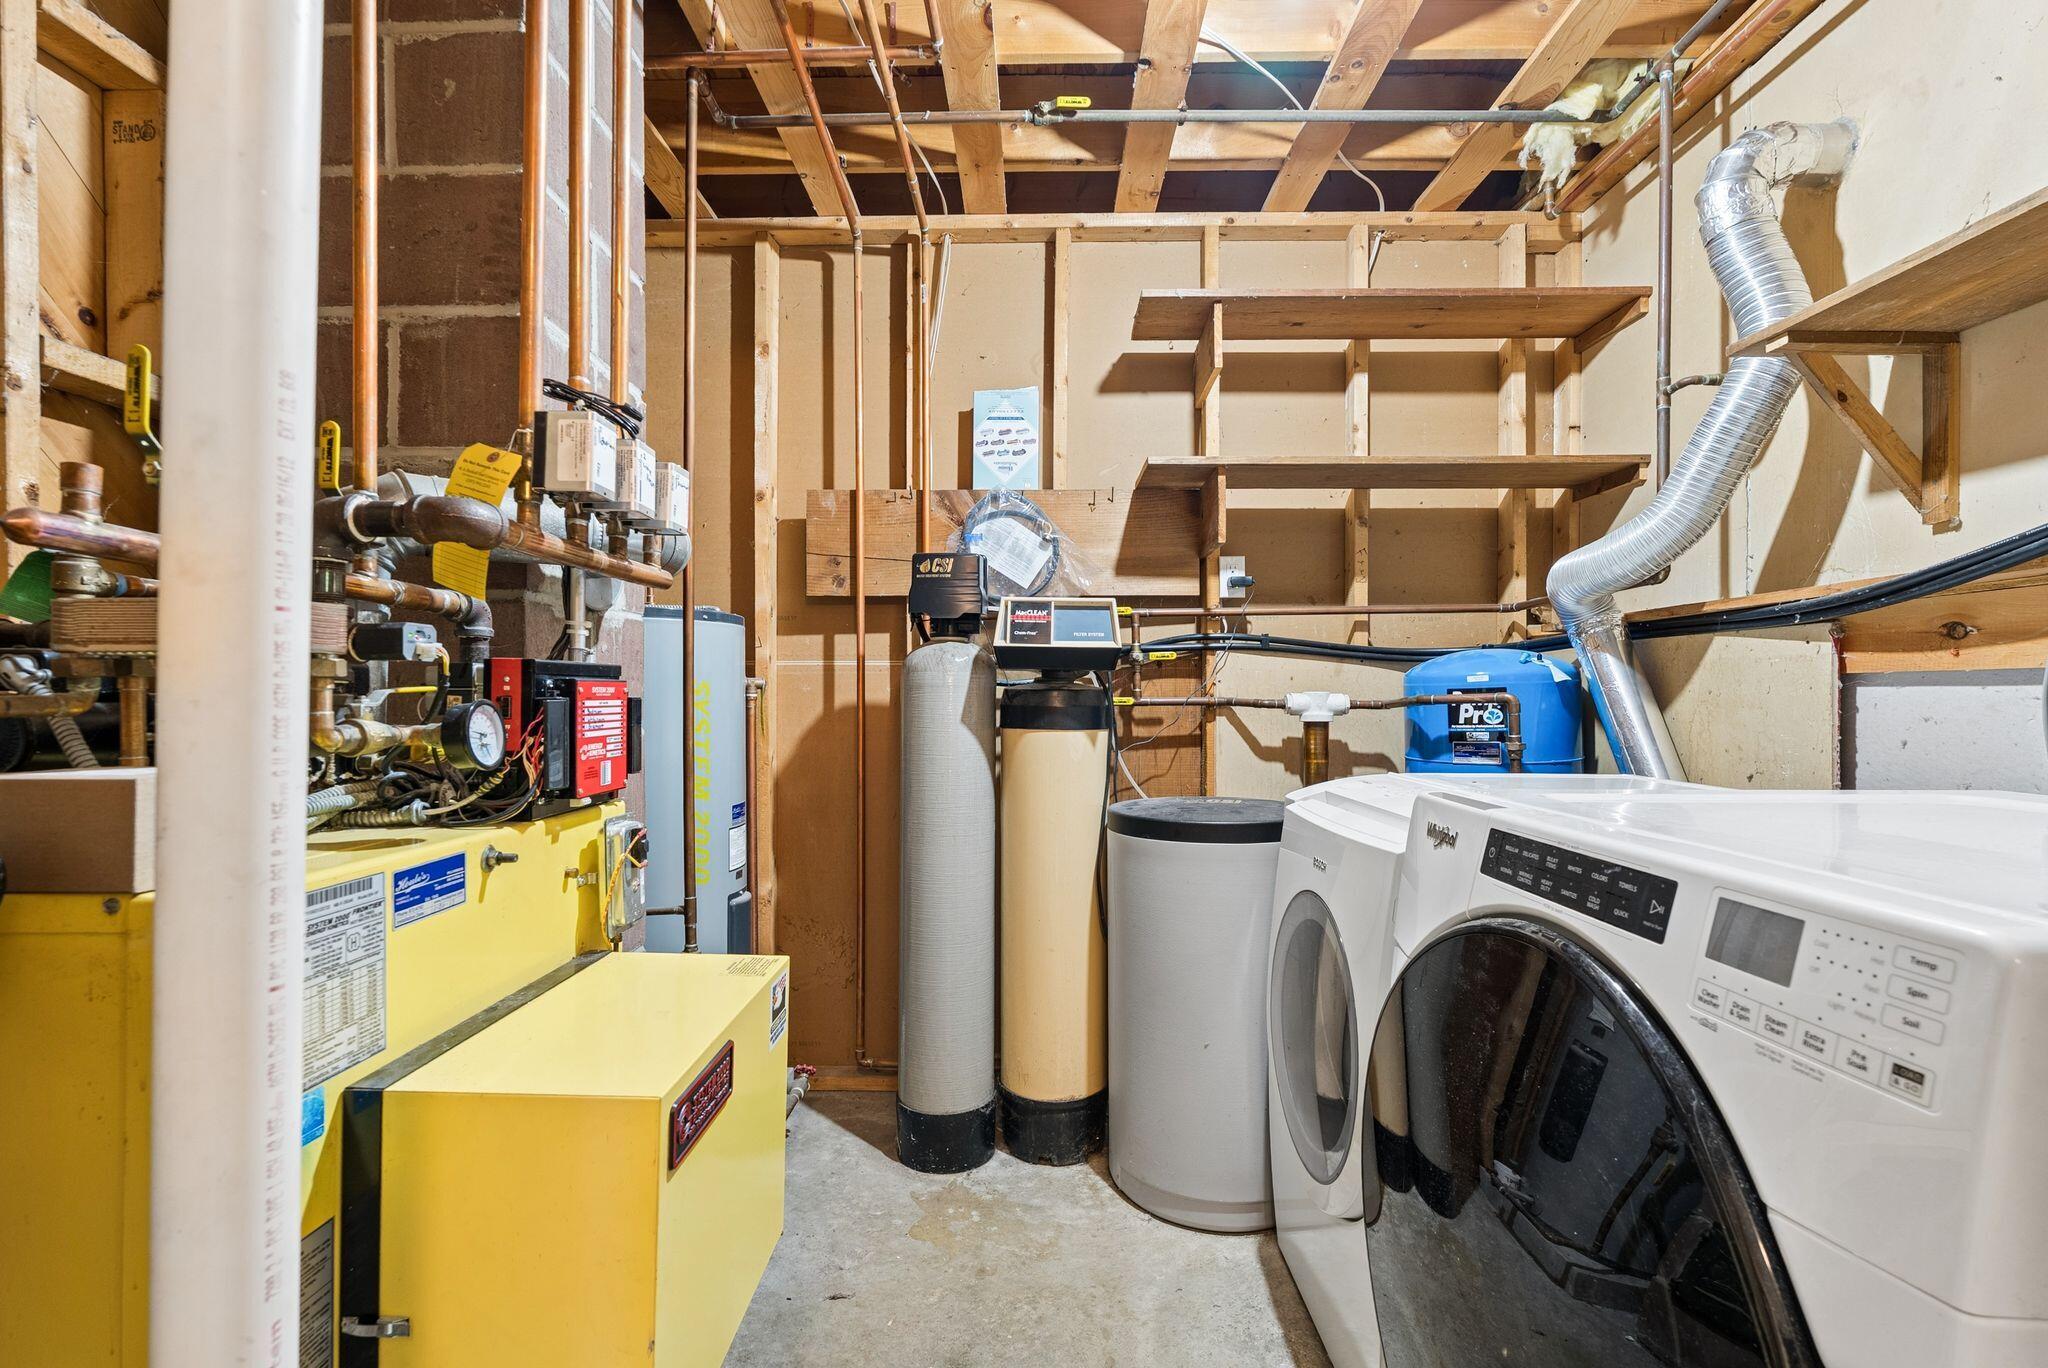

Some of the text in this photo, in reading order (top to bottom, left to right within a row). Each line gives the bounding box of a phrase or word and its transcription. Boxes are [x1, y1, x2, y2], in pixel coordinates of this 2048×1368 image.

[932, 558, 954, 573] CSI
[1426, 820, 1459, 850] Whirlpool
[1522, 850, 1539, 860] DELICATES
[1591, 872, 1608, 882] COLORS
[1618, 881, 1638, 892] TOWELS
[1561, 888, 1578, 899] SANITIZE
[1588, 896, 1600, 904] COLD
[352, 900, 382, 914] FRONTIER
[1586, 902, 1600, 910] WASH
[1613, 908, 1630, 919] QUICK
[306, 918, 333, 932] SYSTEM
[1910, 955, 1938, 972] Temp
[1702, 988, 1719, 1000] Clean
[1906, 986, 1929, 1000] Spin
[1697, 994, 1720, 1009] Washer
[1732, 1001, 1750, 1013] Drain
[1736, 1011, 1750, 1022] Spin
[1765, 1014, 1788, 1029] Steam
[1902, 1016, 1920, 1029] Soil
[1764, 1024, 1786, 1038] Clean
[1804, 1031, 1826, 1045] Extra
[1802, 1039, 1824, 1054] Rinse
[1851, 1049, 1866, 1061] Pre
[1846, 1057, 1868, 1072] Soak
